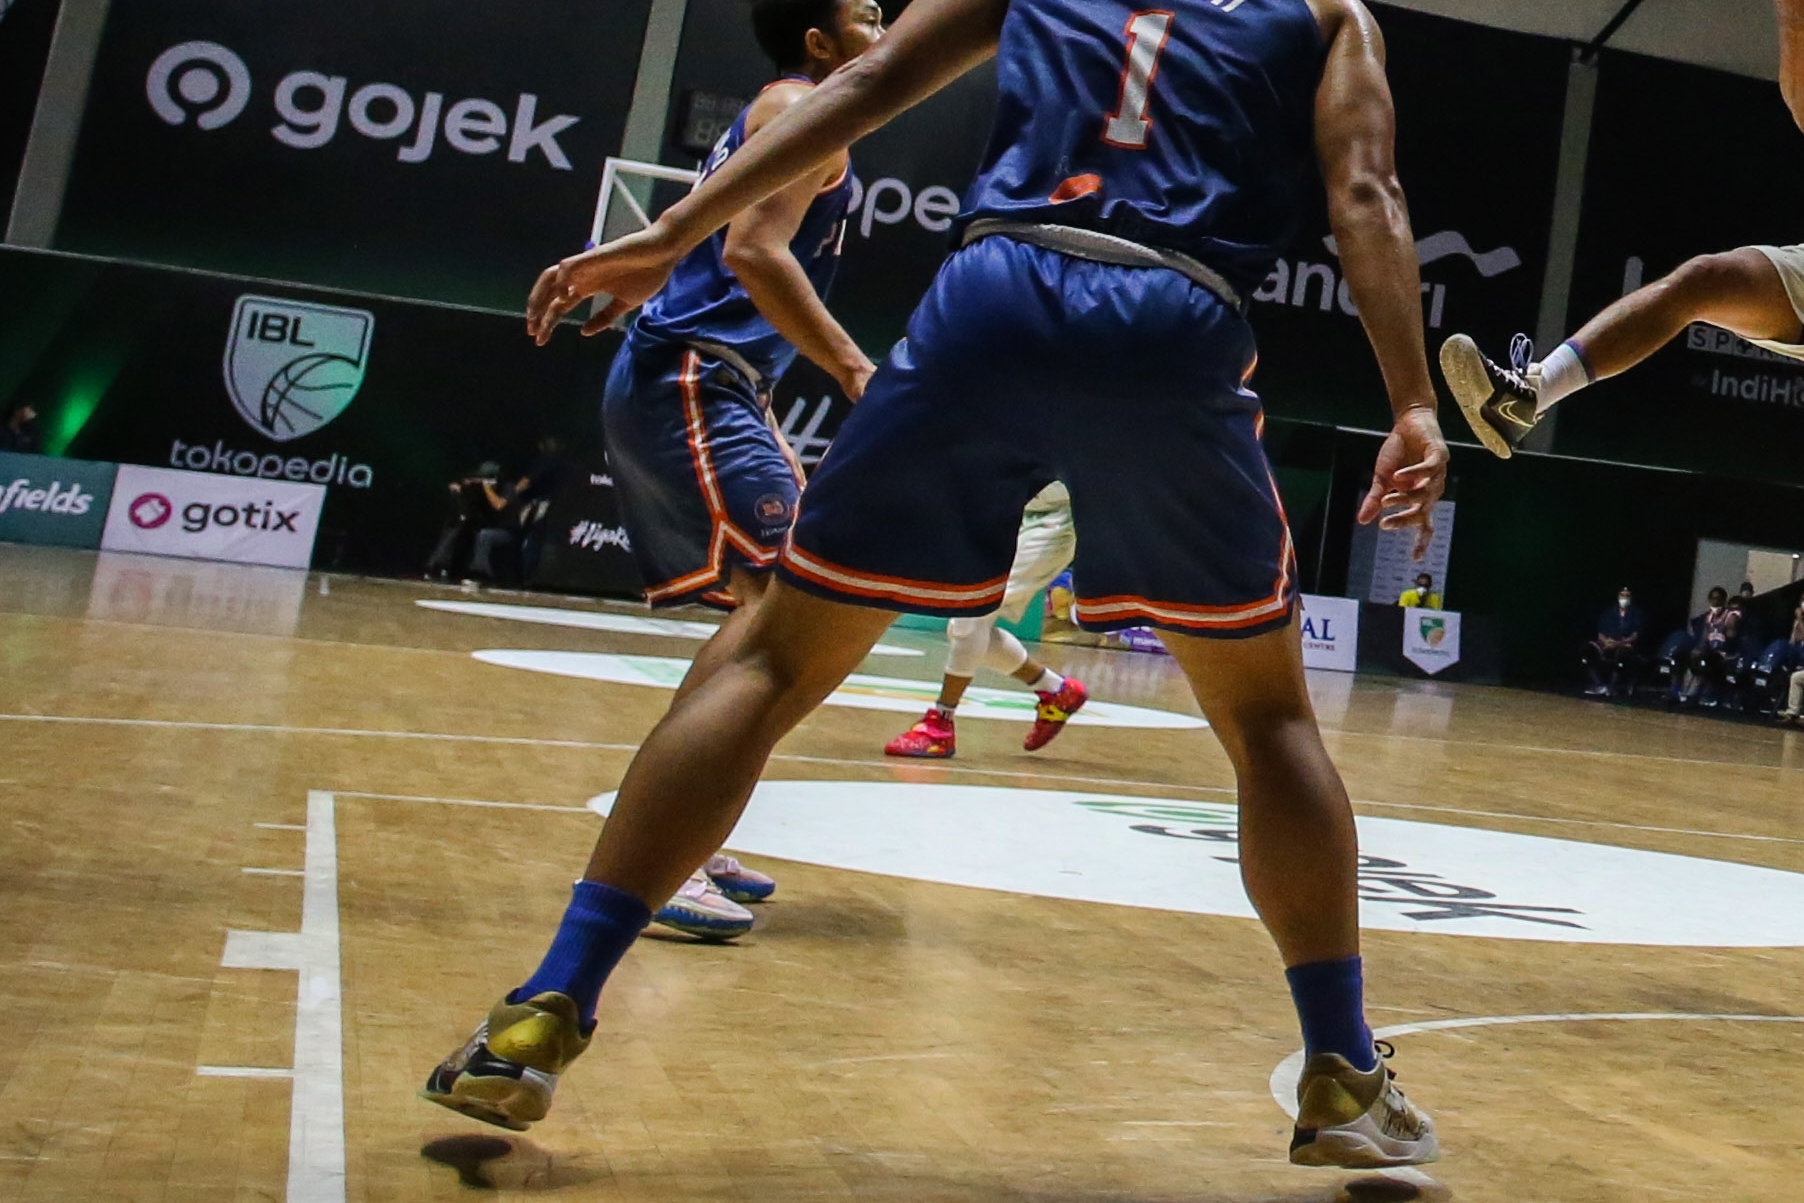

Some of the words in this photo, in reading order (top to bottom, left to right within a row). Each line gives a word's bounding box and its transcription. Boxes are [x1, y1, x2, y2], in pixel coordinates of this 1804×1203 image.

[1104, 8, 1175, 150] 1
[271, 70, 581, 171] gojek
[246, 310, 315, 347] IBL
[170, 438, 375, 489] tokopedia
[181, 498, 300, 534] gotix
